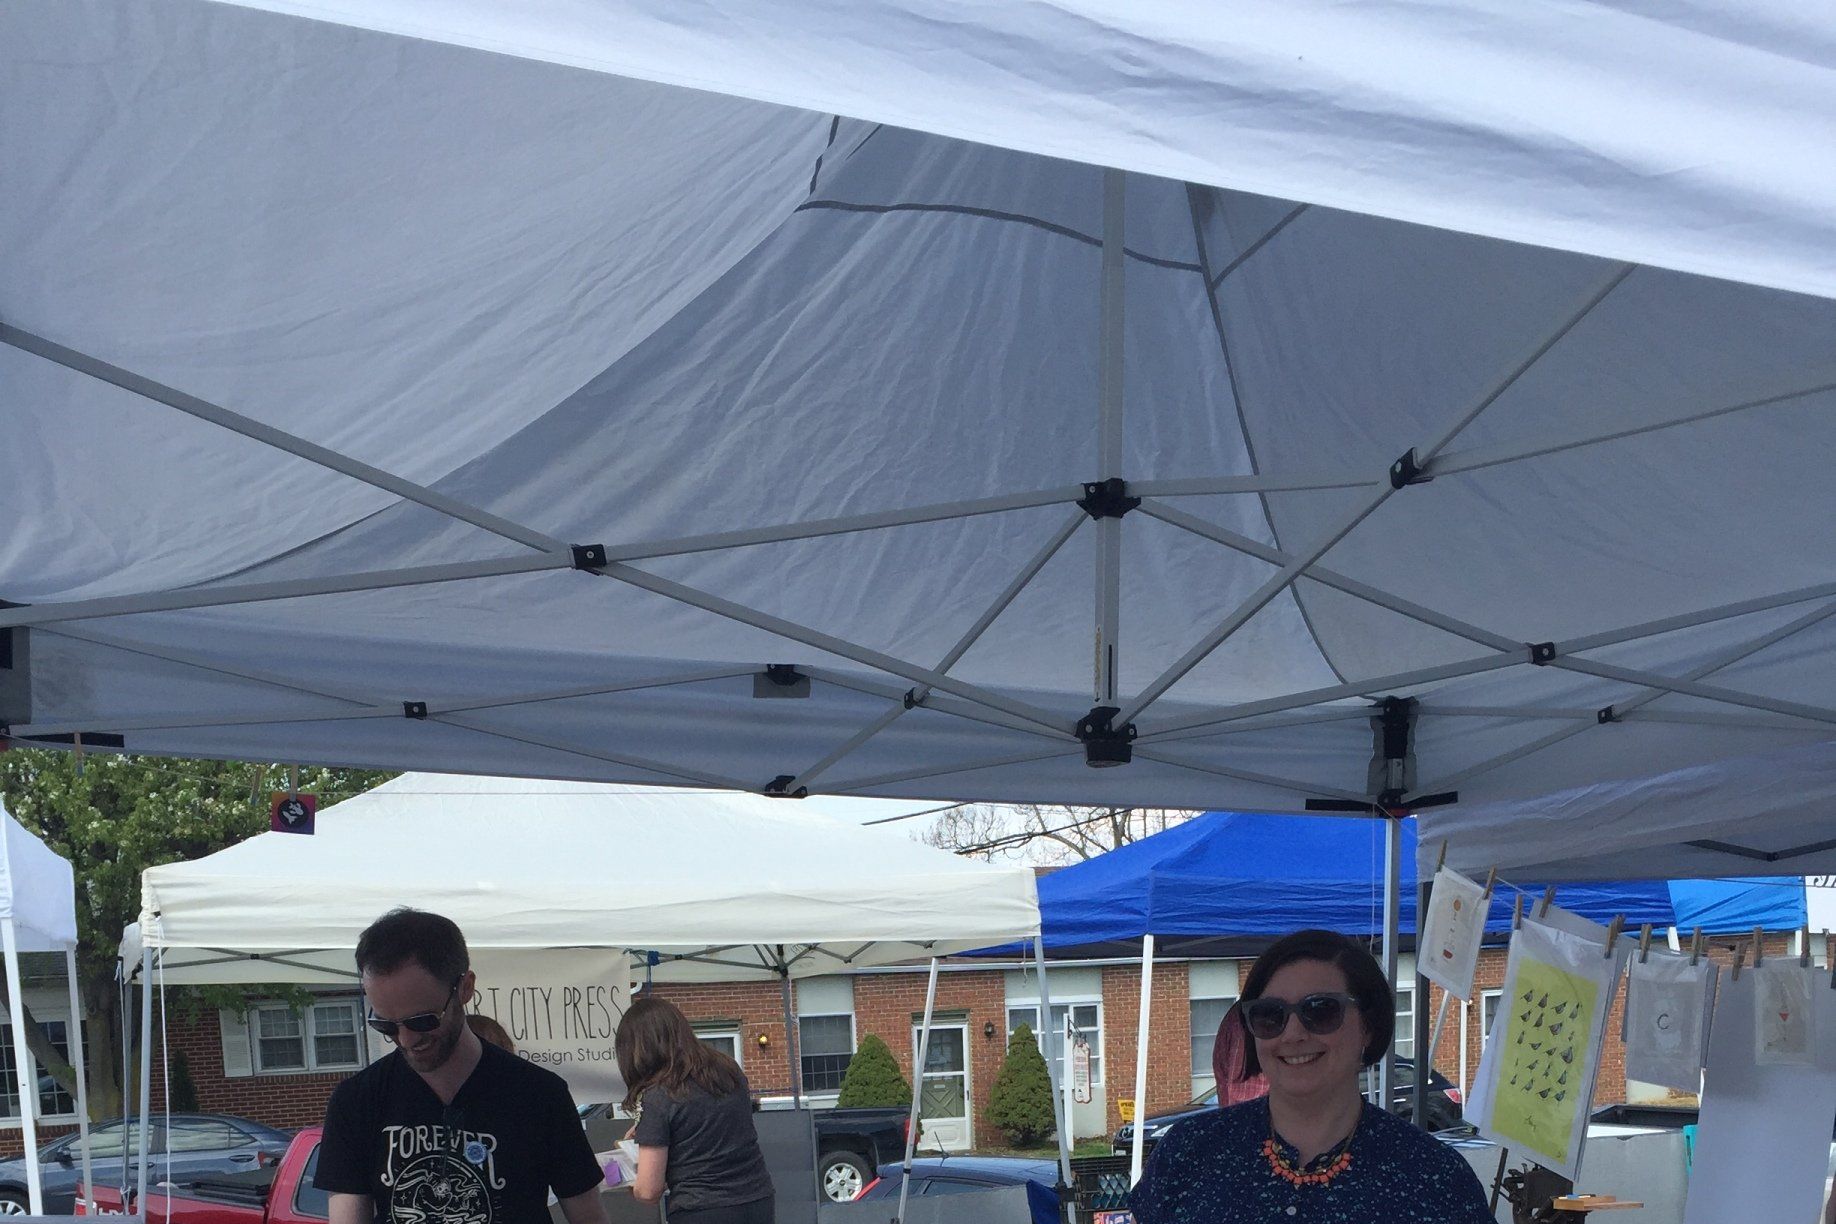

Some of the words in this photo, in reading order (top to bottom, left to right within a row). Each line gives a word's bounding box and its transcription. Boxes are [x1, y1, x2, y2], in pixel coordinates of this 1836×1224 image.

[510, 986, 553, 1041] CITY
[563, 985, 626, 1040] PRESS
[518, 1048, 573, 1066] Design
[577, 1046, 618, 1063] Studi
[380, 1124, 507, 1190] FOREVER
